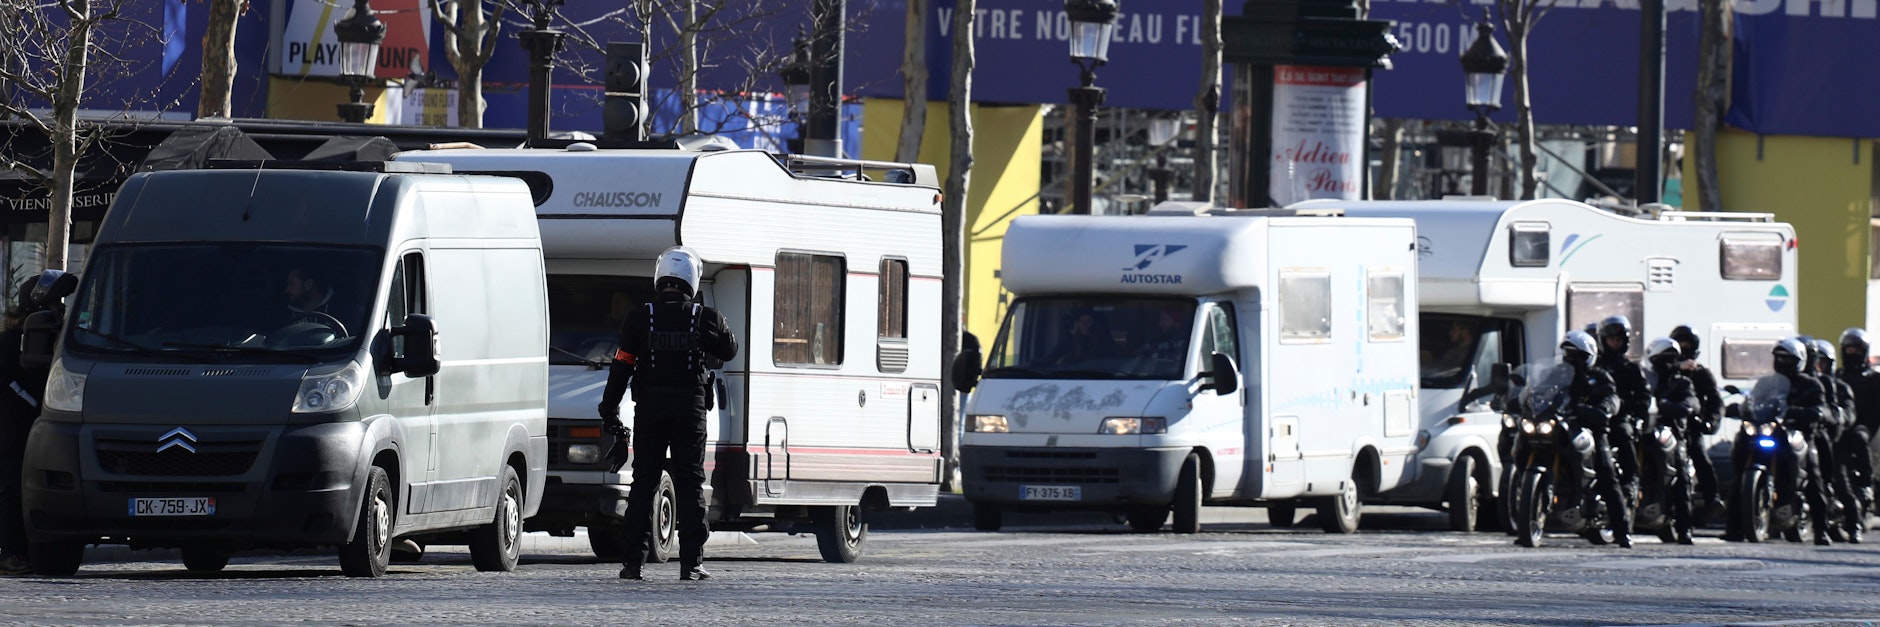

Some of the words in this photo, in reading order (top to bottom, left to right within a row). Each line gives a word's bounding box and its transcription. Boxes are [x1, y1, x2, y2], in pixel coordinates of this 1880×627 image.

[938, 8, 1023, 39] VTRE
[1036, 11, 1163, 44] NOEAU
[289, 42, 421, 69] PLAYUND
[1276, 139, 1350, 164] Adieu
[1306, 167, 1356, 192] Paris
[9, 193, 116, 211] VIENNISERI
[573, 192, 662, 207] CHAUSSON
[1121, 274, 1183, 284] AUTOSTAR
[651, 333, 697, 349] POLICE
[137, 499, 207, 514] CK-759-JX
